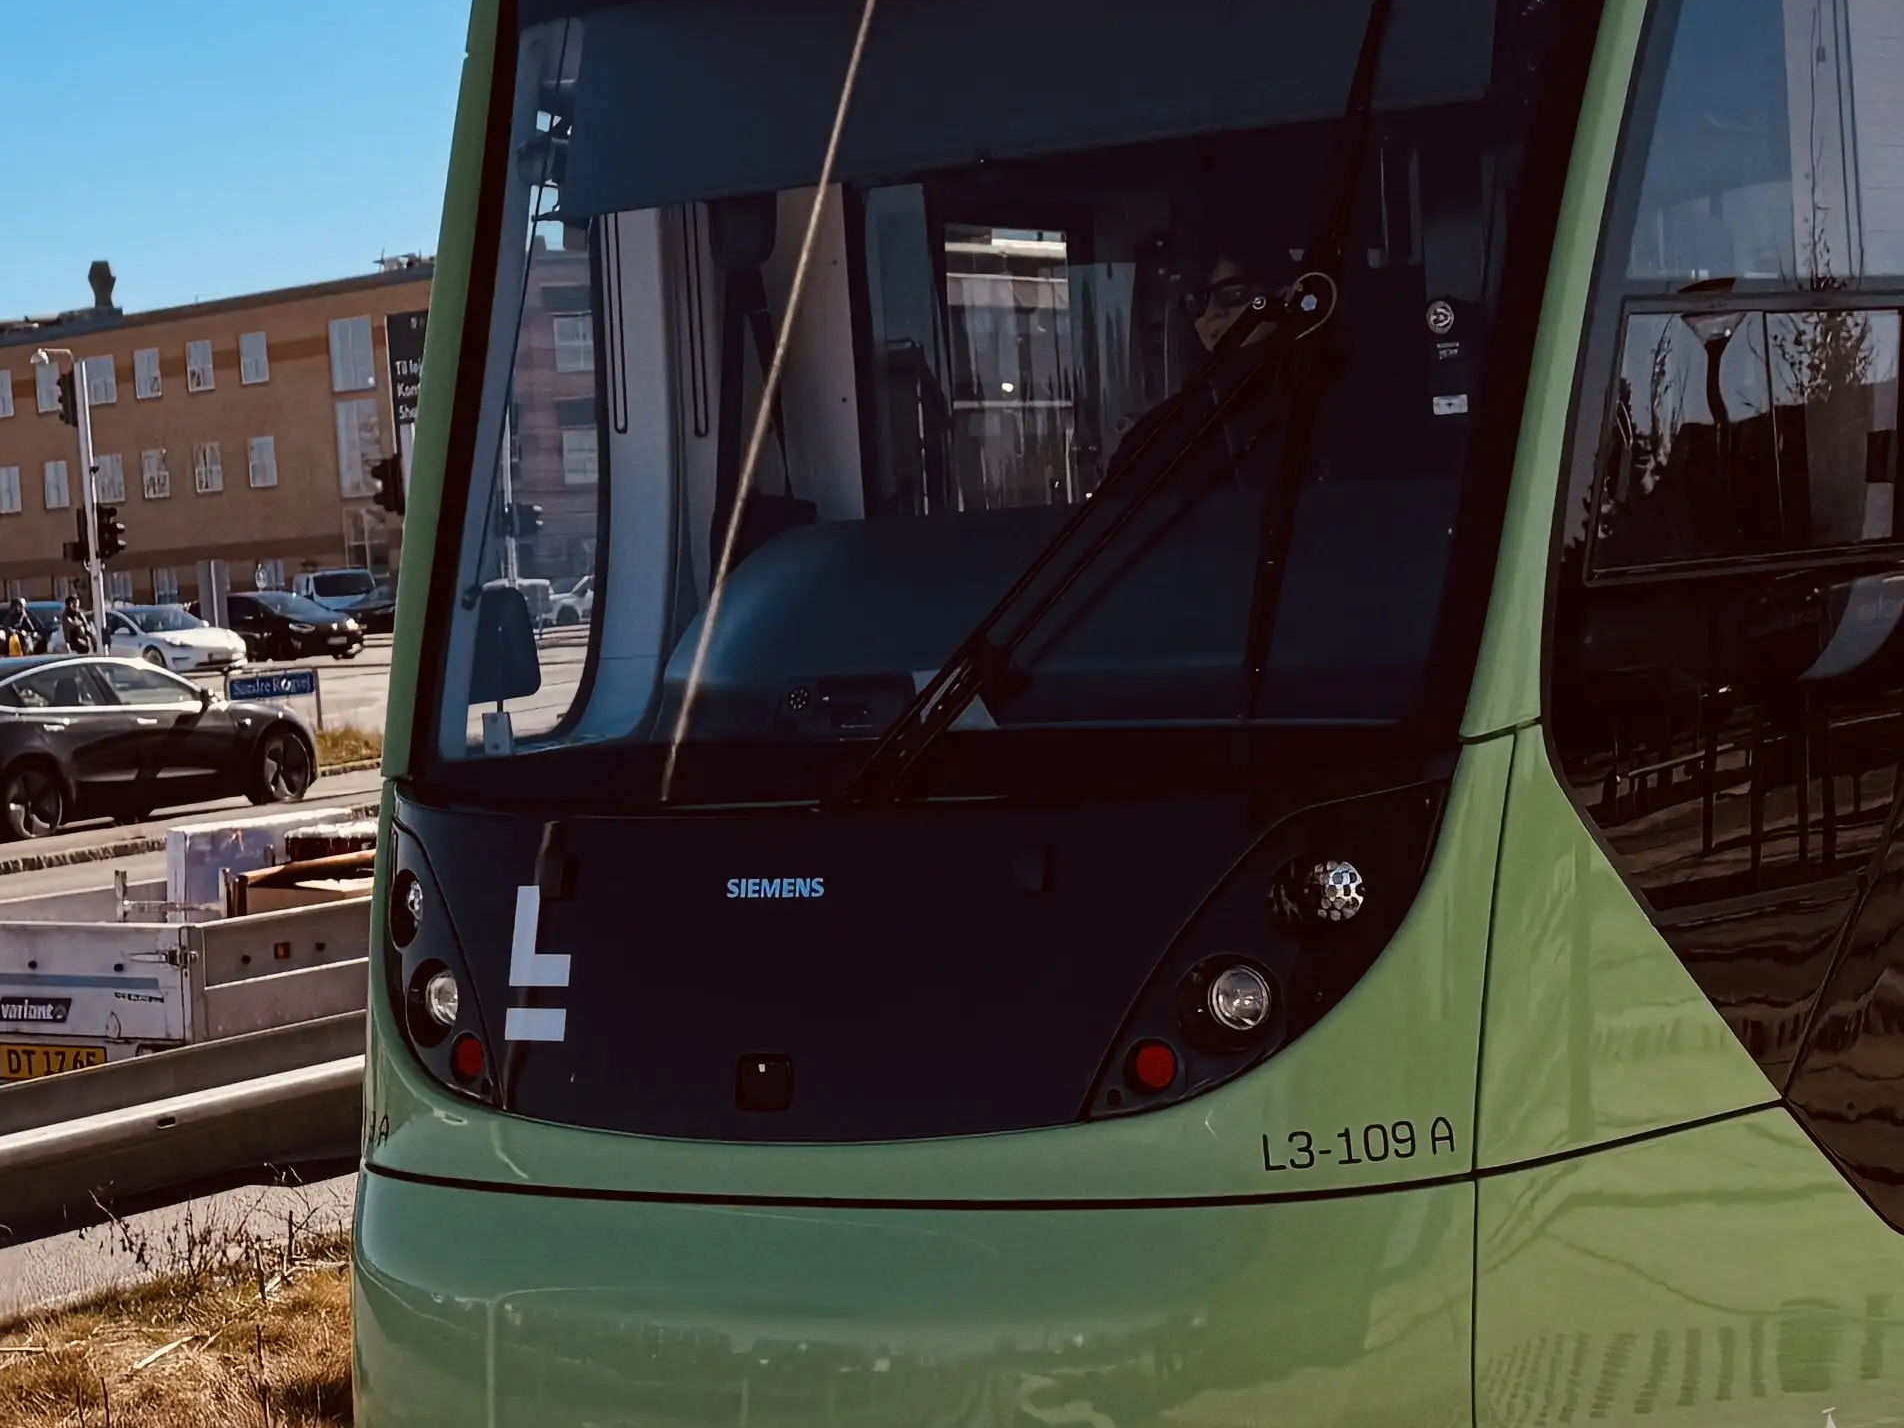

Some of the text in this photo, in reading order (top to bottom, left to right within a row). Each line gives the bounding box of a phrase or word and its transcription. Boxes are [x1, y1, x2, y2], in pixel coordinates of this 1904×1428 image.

[726, 877, 825, 898] SIEMENS
[0, 998, 53, 1021] variant
[6, 1048, 35, 1075] DT
[42, 1050, 66, 1075] 17
[1262, 1116, 1455, 1171] L3-109 A
